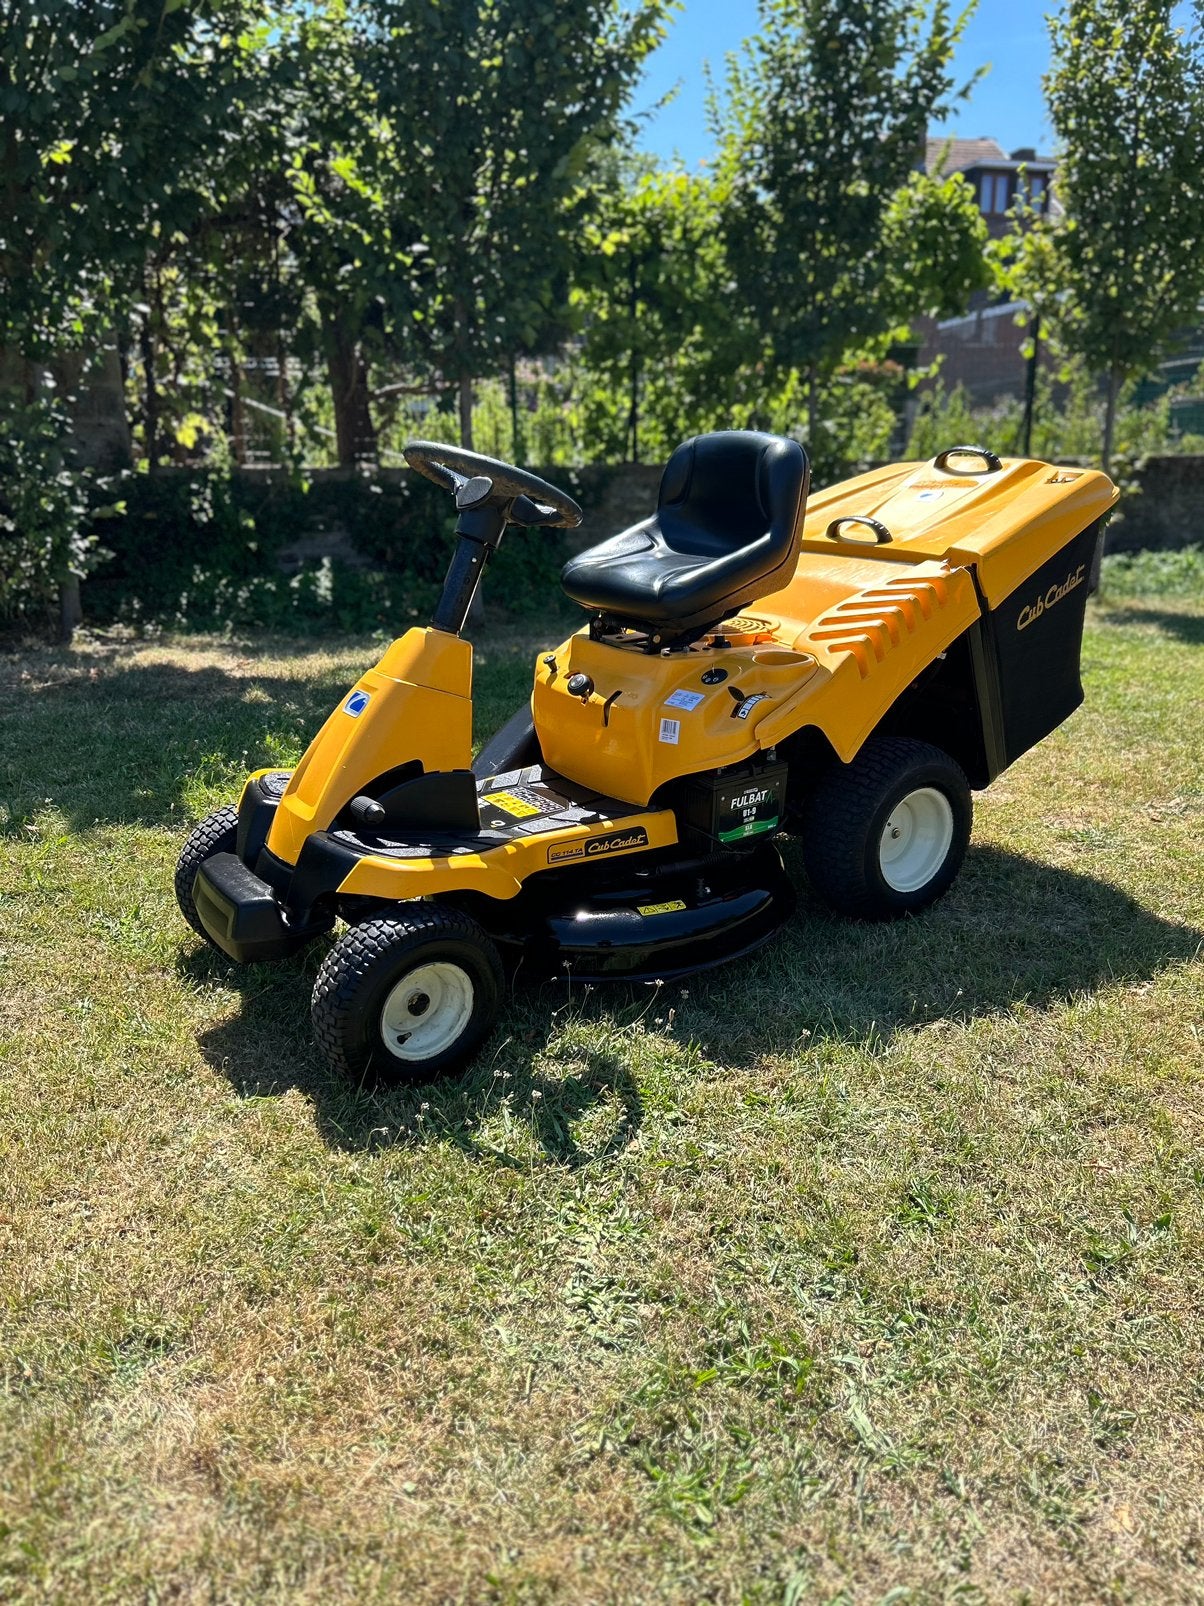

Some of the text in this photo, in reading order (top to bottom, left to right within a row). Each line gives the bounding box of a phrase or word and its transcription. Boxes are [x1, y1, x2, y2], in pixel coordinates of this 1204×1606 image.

[1017, 565, 1085, 630] Cub Cadet
[730, 789, 768, 809] FULBAT
[588, 834, 646, 854] Cub Cadet
